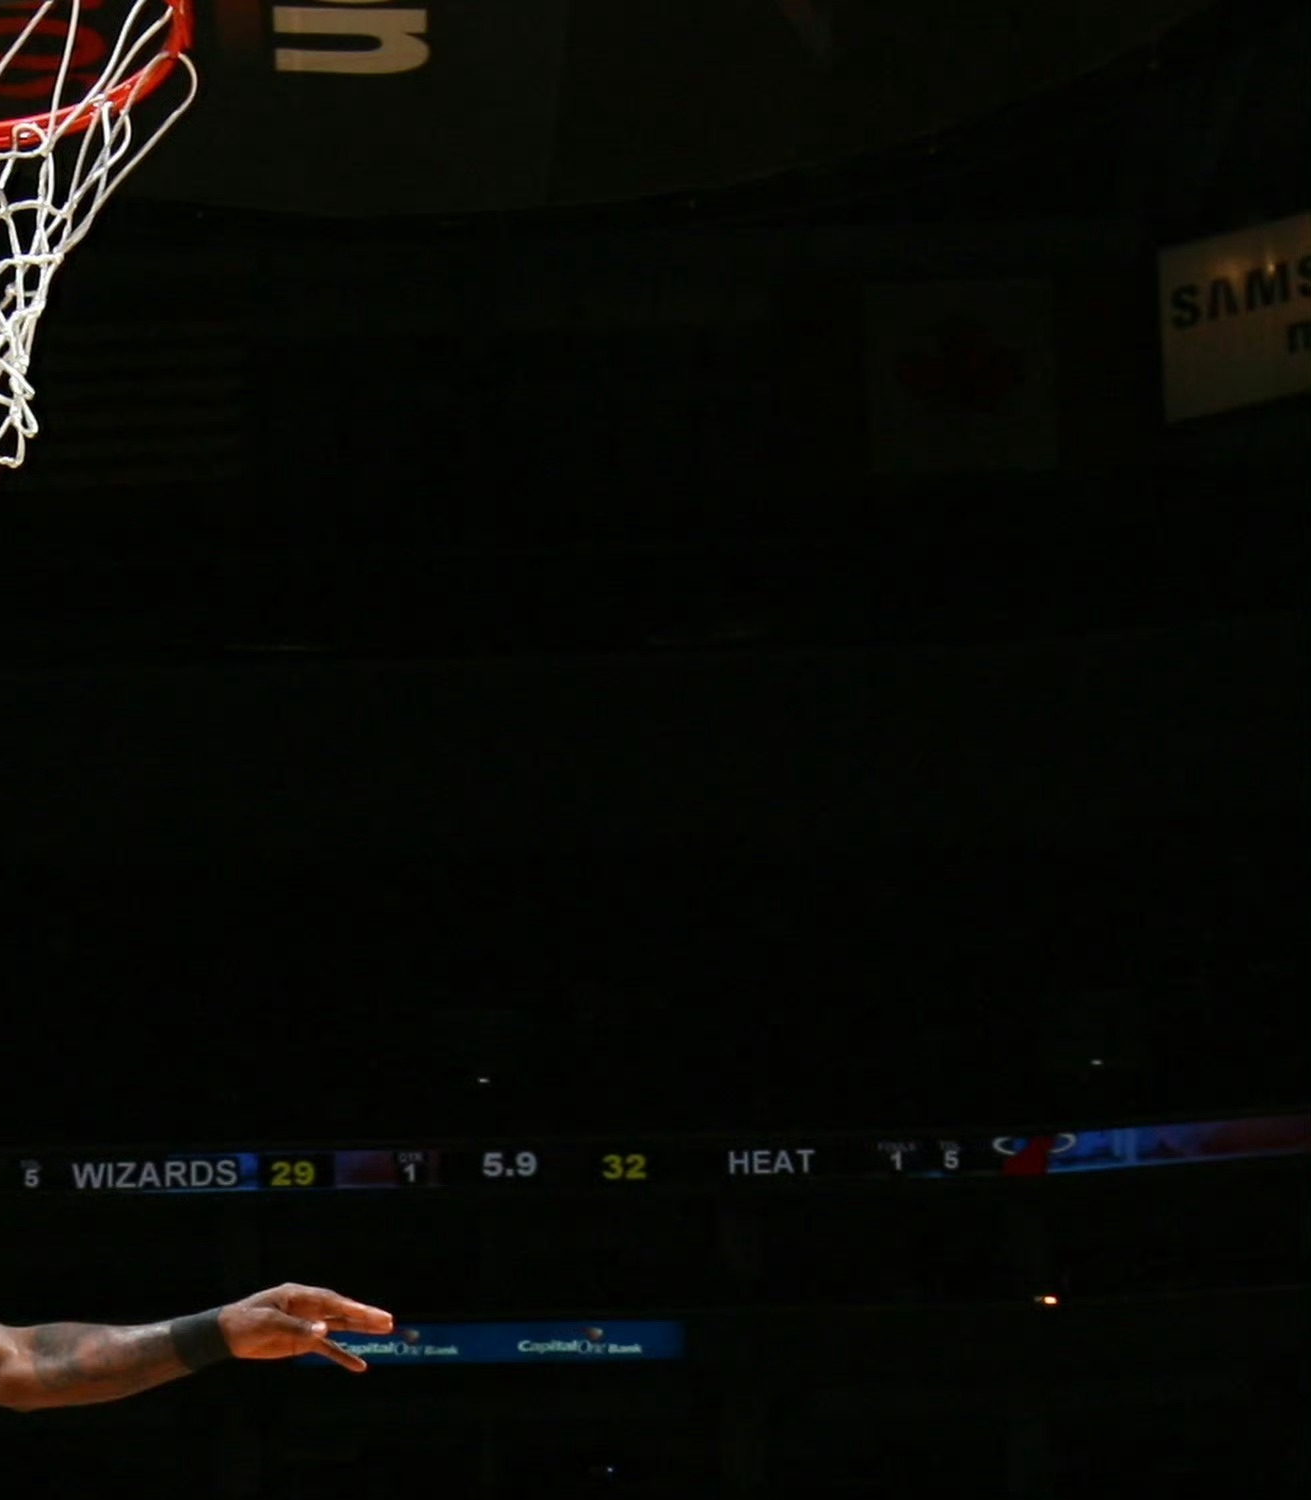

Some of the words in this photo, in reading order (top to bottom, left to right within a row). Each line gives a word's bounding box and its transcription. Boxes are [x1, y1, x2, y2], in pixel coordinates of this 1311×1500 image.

[403, 1163, 417, 1183] 1
[482, 1152, 538, 1177] 5.9
[602, 1154, 647, 1180] 32
[728, 1149, 815, 1175] HEAT
[890, 1151, 902, 1171] 1
[944, 1150, 959, 1169] 5
[72, 1160, 238, 1189] WIZARDS
[271, 1161, 315, 1186] 29
